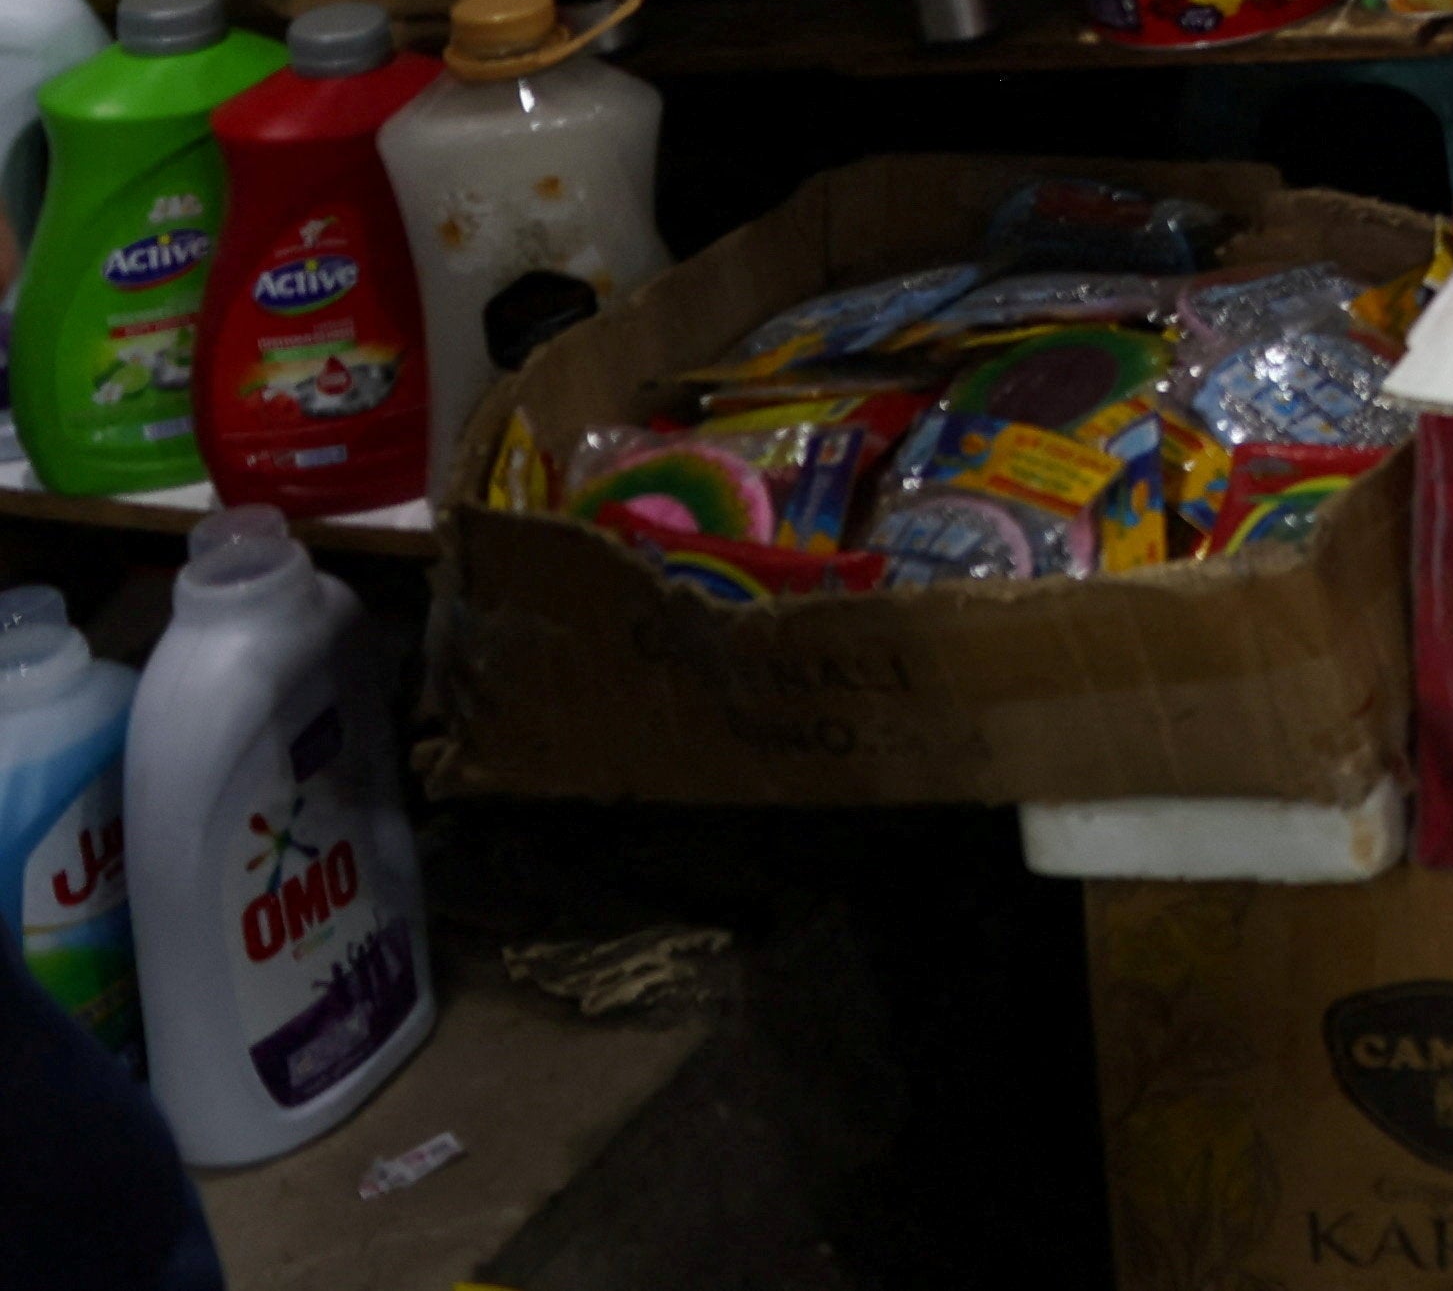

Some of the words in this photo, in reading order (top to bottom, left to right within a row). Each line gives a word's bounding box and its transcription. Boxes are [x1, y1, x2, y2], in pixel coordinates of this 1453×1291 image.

[102, 229, 211, 278] Active
[251, 261, 361, 301] Active
[241, 838, 359, 965] OMO
